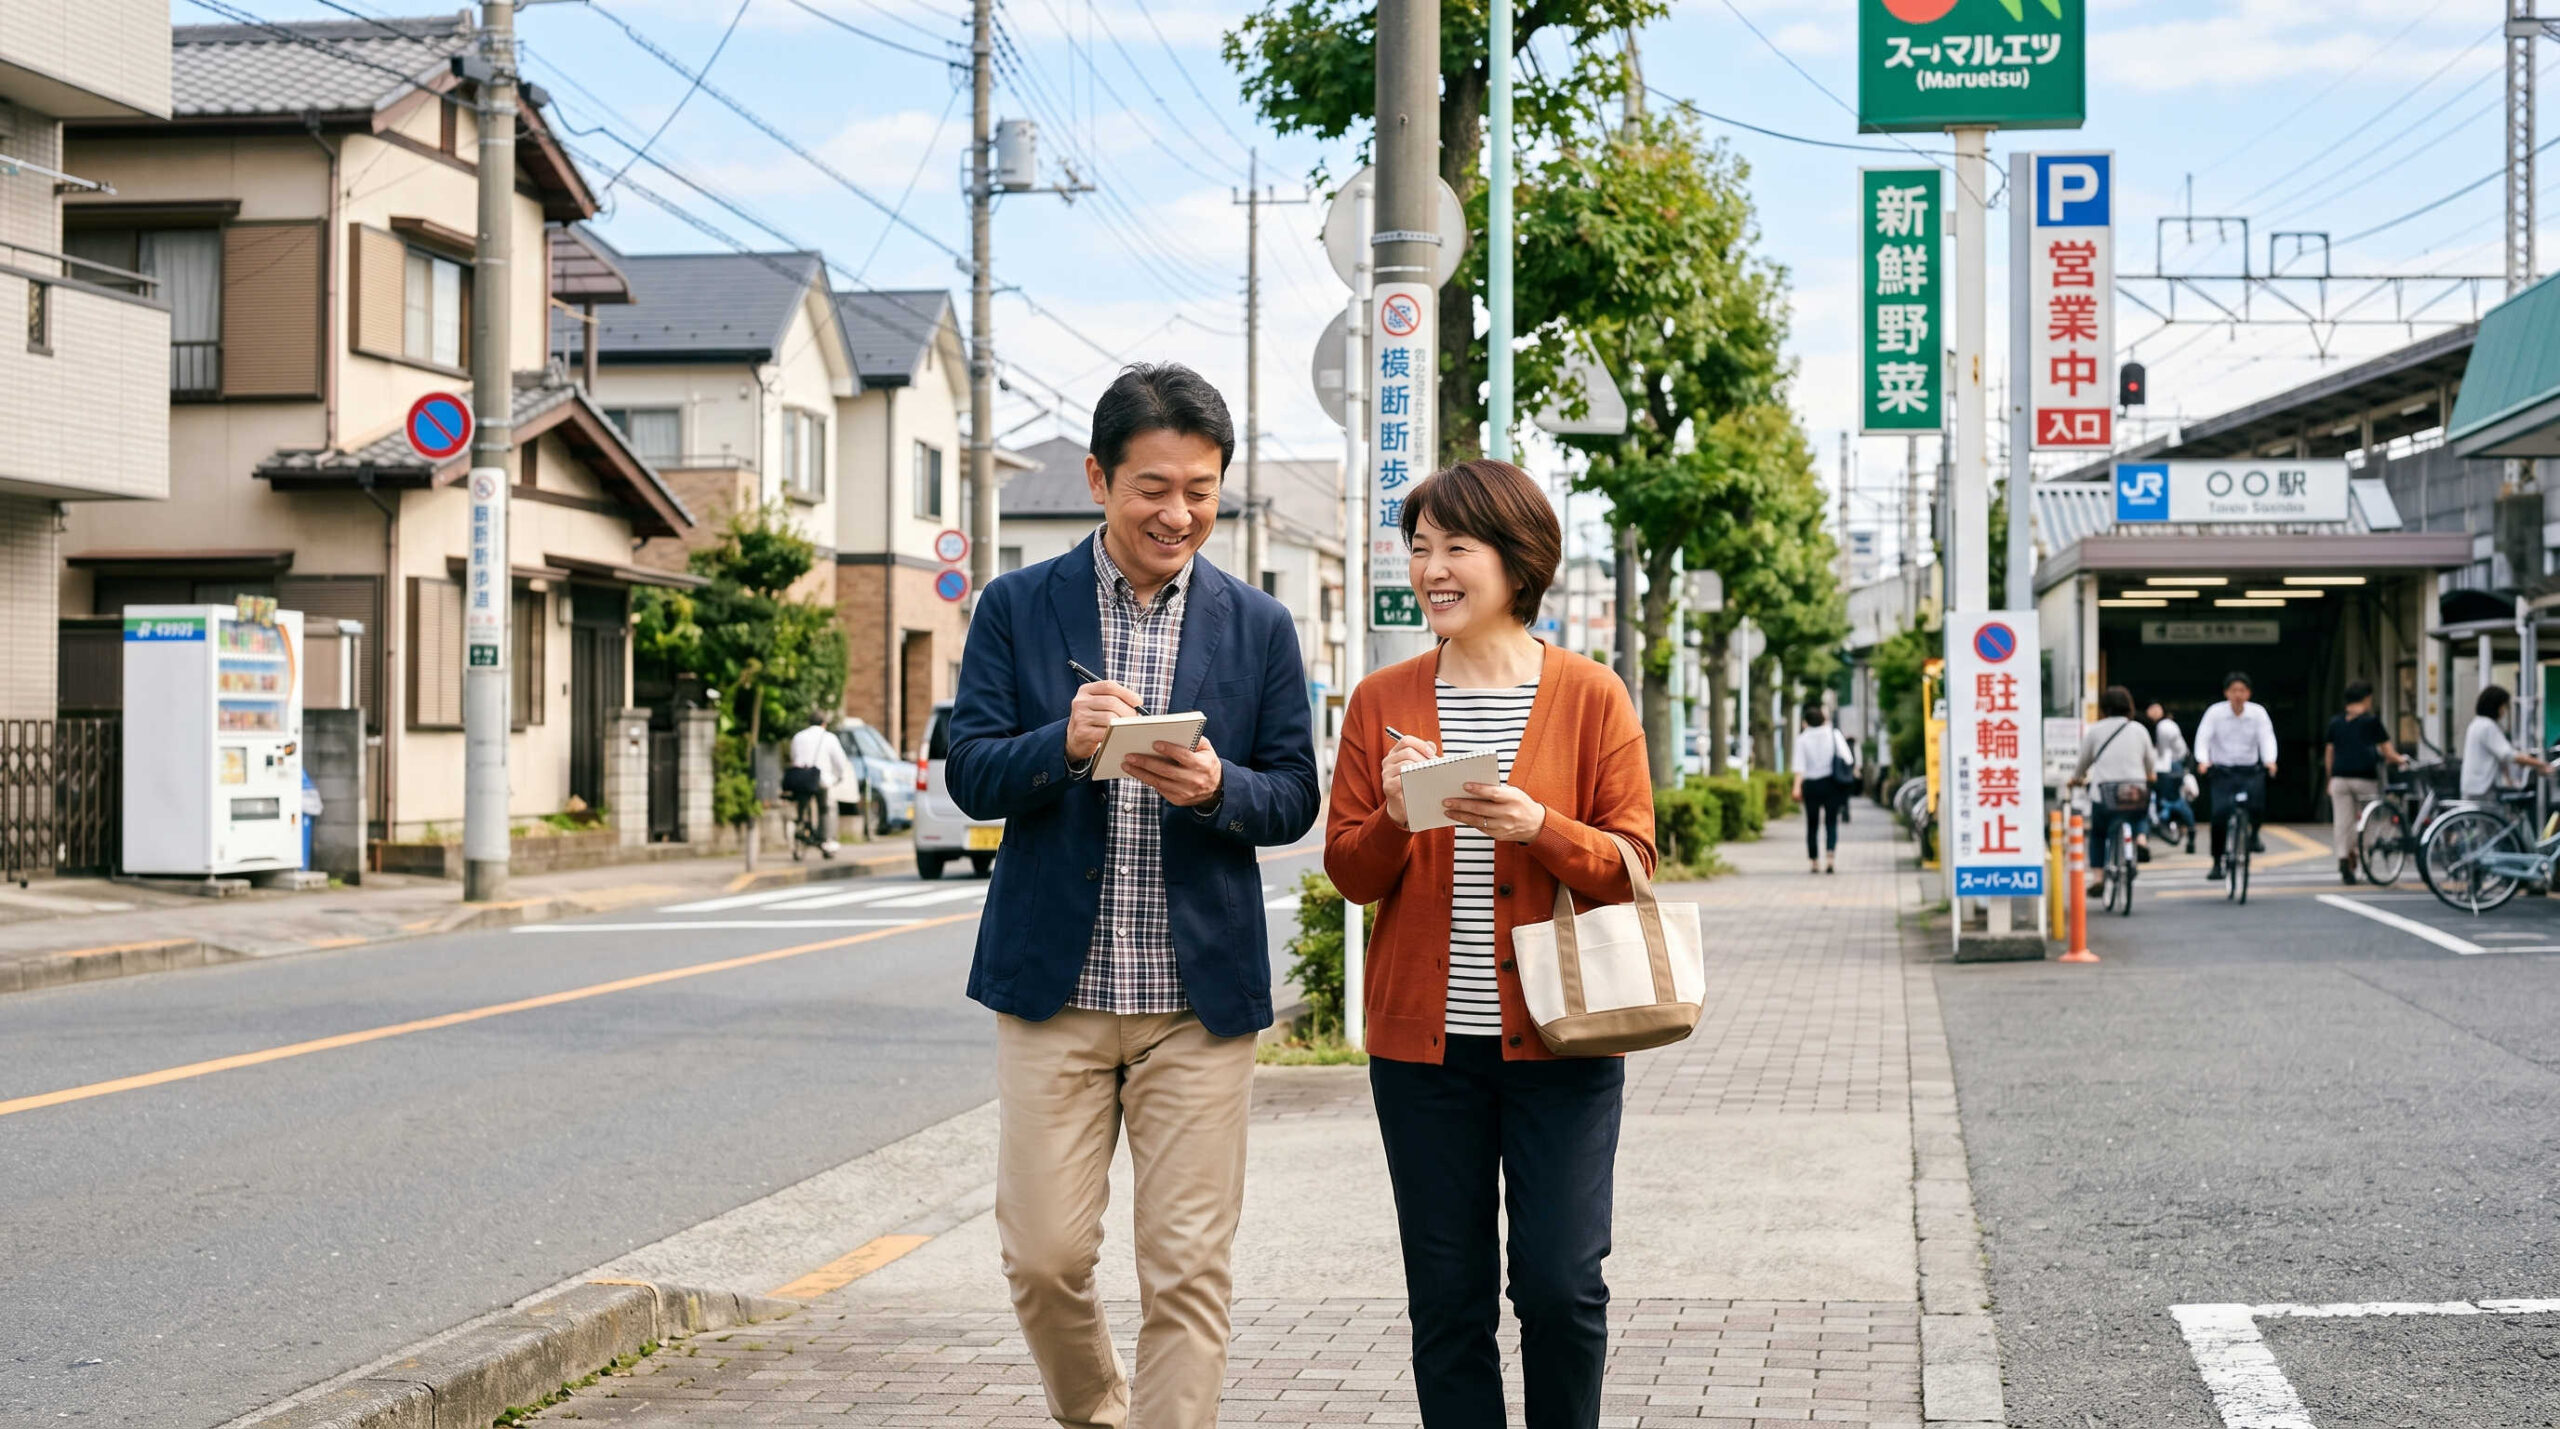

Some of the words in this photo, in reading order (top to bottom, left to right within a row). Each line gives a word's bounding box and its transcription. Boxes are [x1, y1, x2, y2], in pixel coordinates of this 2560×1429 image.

[1916, 68, 2030, 91] (Maruetsu)
[2049, 164, 2099, 221] P
[1876, 185, 1929, 414] 新鮮野菜
[2048, 241, 2097, 398] 営業中
[2046, 413, 2101, 440] 入口
[2120, 472, 2164, 498] JR
[1976, 673, 2021, 855] 駐輪禁止
[1960, 871, 2038, 889] スーパー入口
